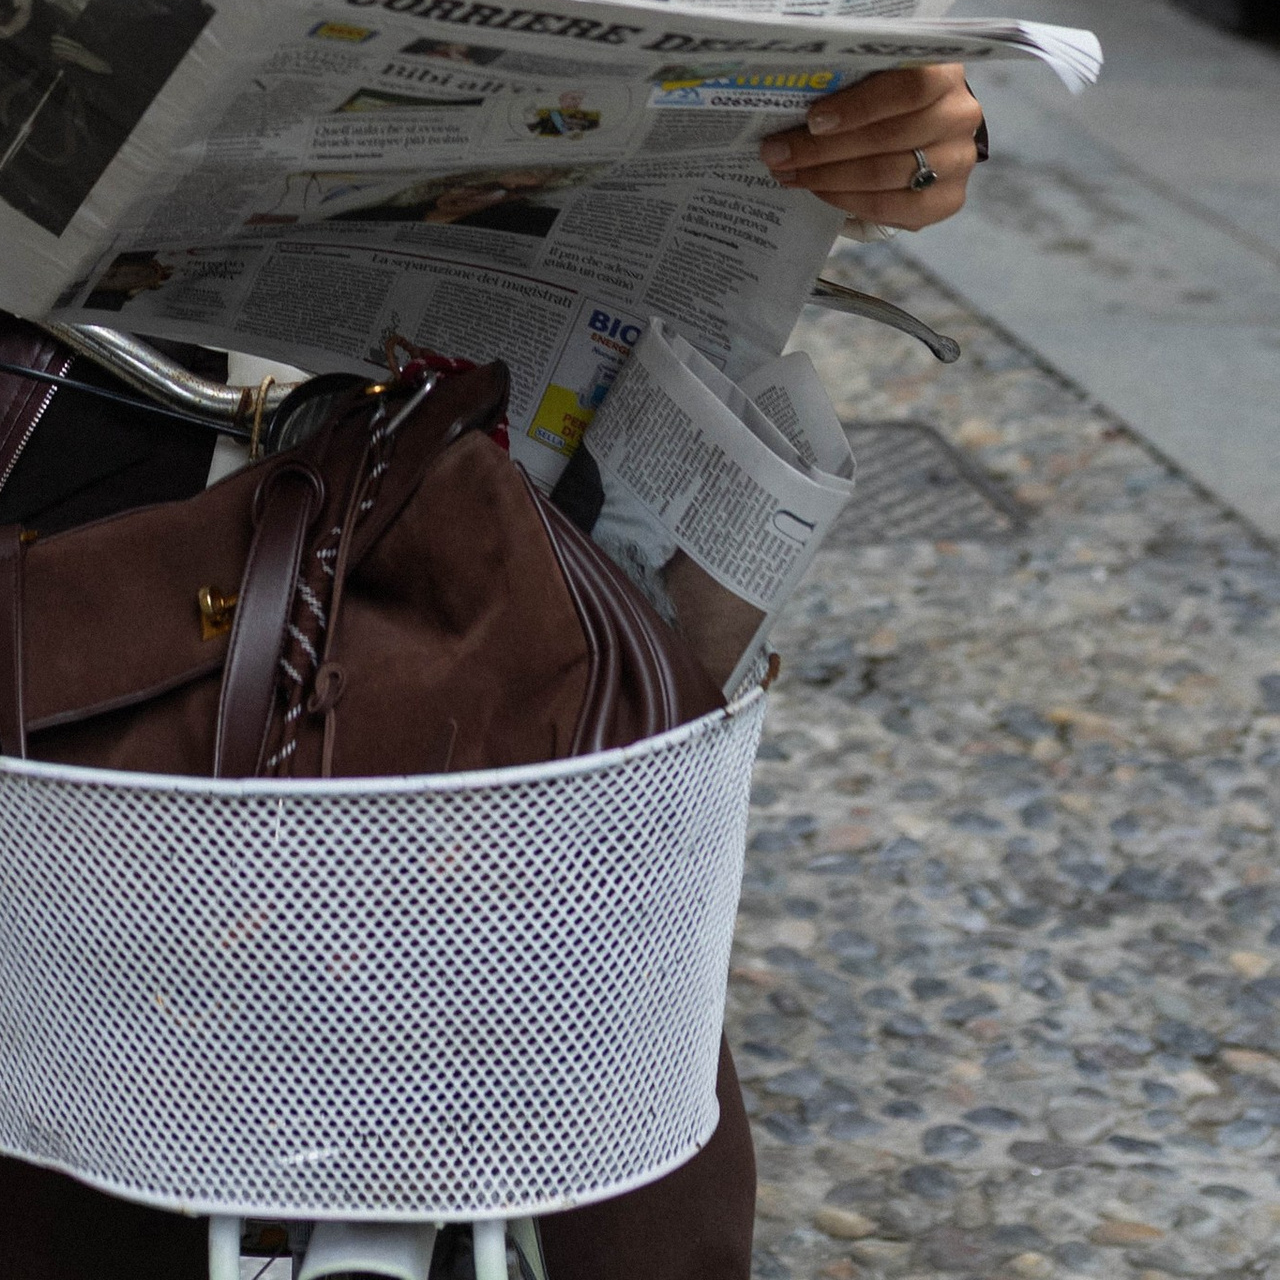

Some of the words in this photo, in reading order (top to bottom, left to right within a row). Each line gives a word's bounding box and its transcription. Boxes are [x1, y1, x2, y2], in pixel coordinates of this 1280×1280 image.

[641, 32, 829, 55] DELLA
[372, 253, 389, 266] La
[391, 259, 475, 281] separazione
[476, 273, 499, 287] dei
[501, 280, 572, 309] magistrati
